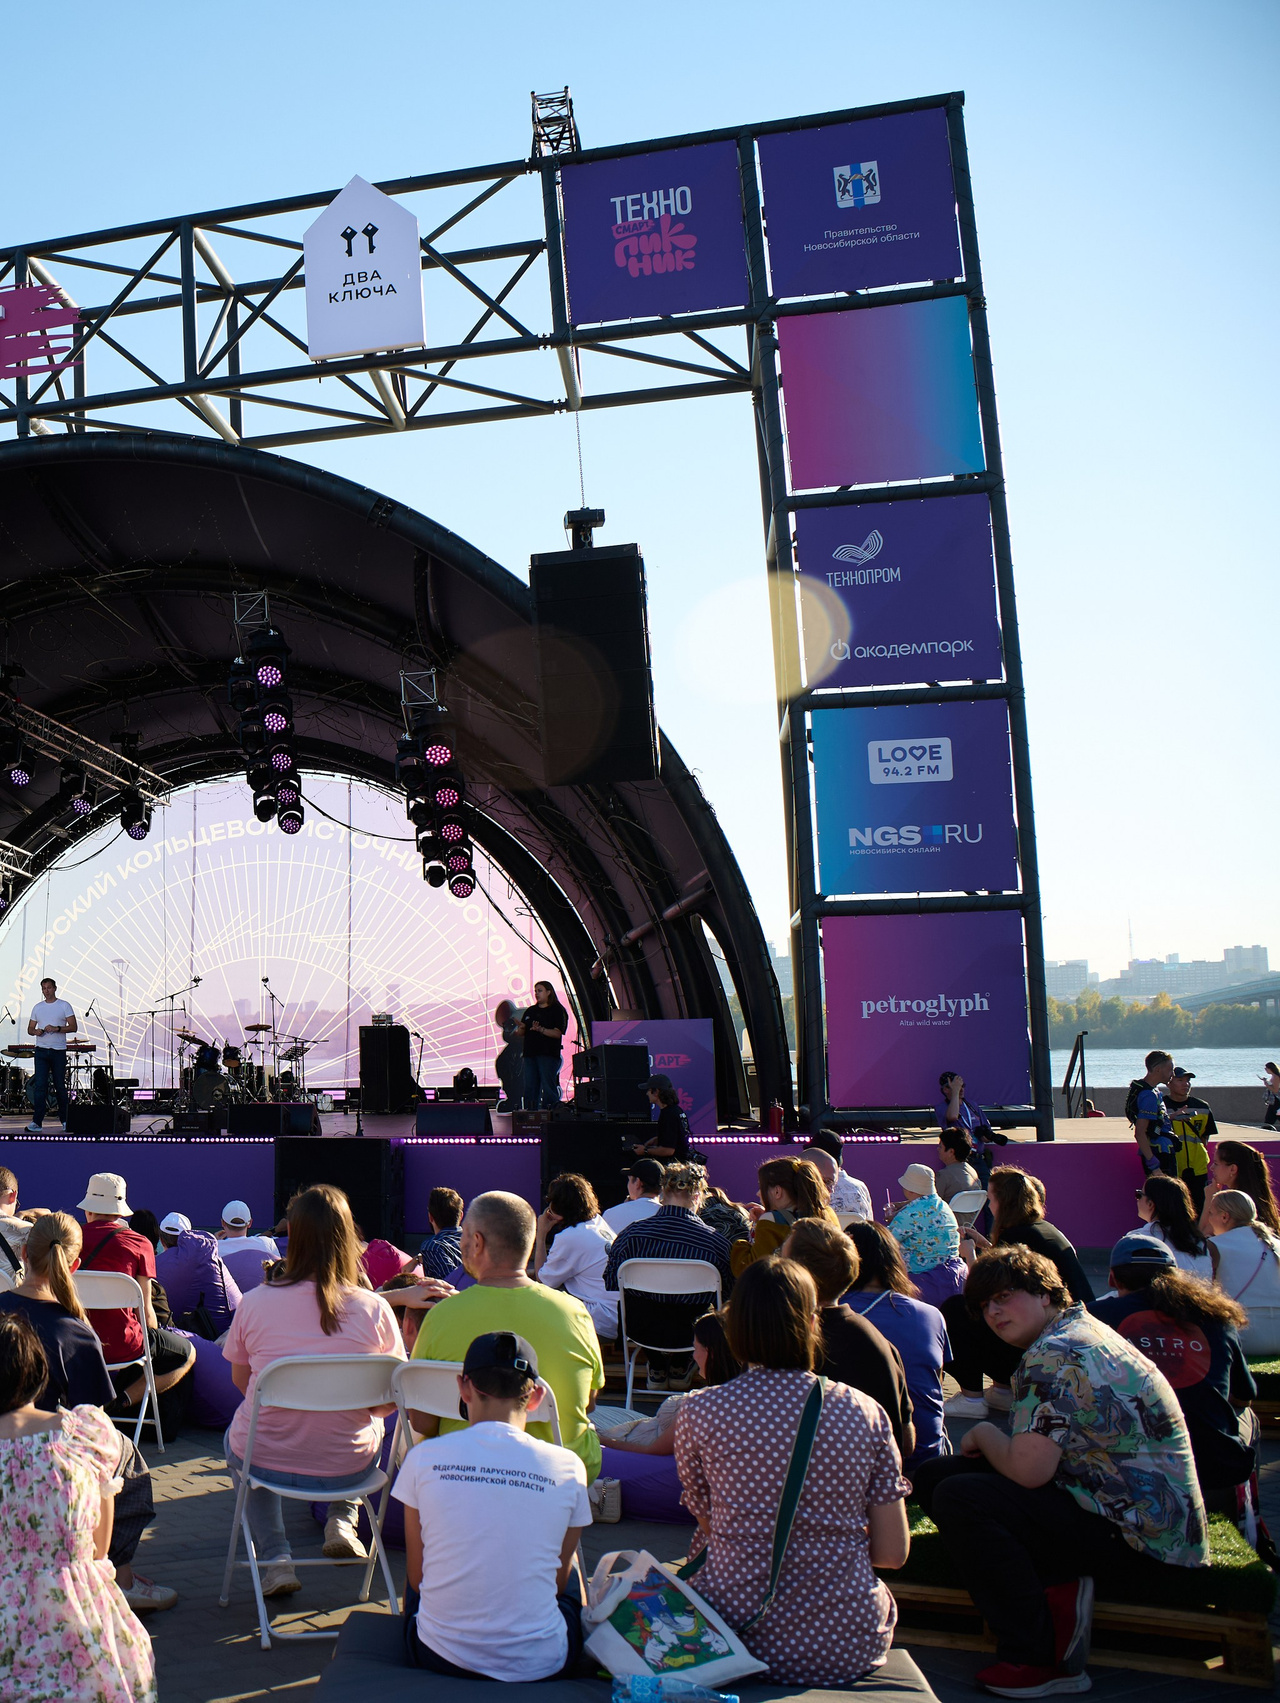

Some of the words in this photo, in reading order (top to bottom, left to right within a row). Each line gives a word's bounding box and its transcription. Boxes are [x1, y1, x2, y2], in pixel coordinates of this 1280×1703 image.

[610, 186, 692, 224] ТЕХНО
[615, 221, 650, 235] СМАРТ
[824, 223, 898, 240] Правительство
[803, 235, 878, 252] Новосибирской
[880, 231, 920, 243] области
[342, 269, 382, 287] ДВА
[329, 283, 397, 304] КЛЮЧА
[826, 567, 901, 587] ТЕХНОПРОМ
[854, 639, 974, 658] академпарк
[878, 744, 942, 763] LOVE
[883, 766, 912, 777] 94.2
[917, 765, 940, 775] FM
[848, 825, 922, 847] NGS
[849, 847, 906, 855] НОВОСИБИРСК
[1, 873, 118, 1020] СИБИРСКИЙ
[297, 819, 425, 878] ИСТОЧНИ
[861, 992, 990, 1019] petroglyph
[432, 1464, 476, 1472] ФЕДЕРАЦИЯ
[480, 1466, 526, 1478] ПАРУСНОГО
[528, 1472, 556, 1487] СПОРТА
[440, 1474, 507, 1486] НОВОСИБИРСКОЙ
[508, 1479, 545, 1493] ОБЛАСТИ
